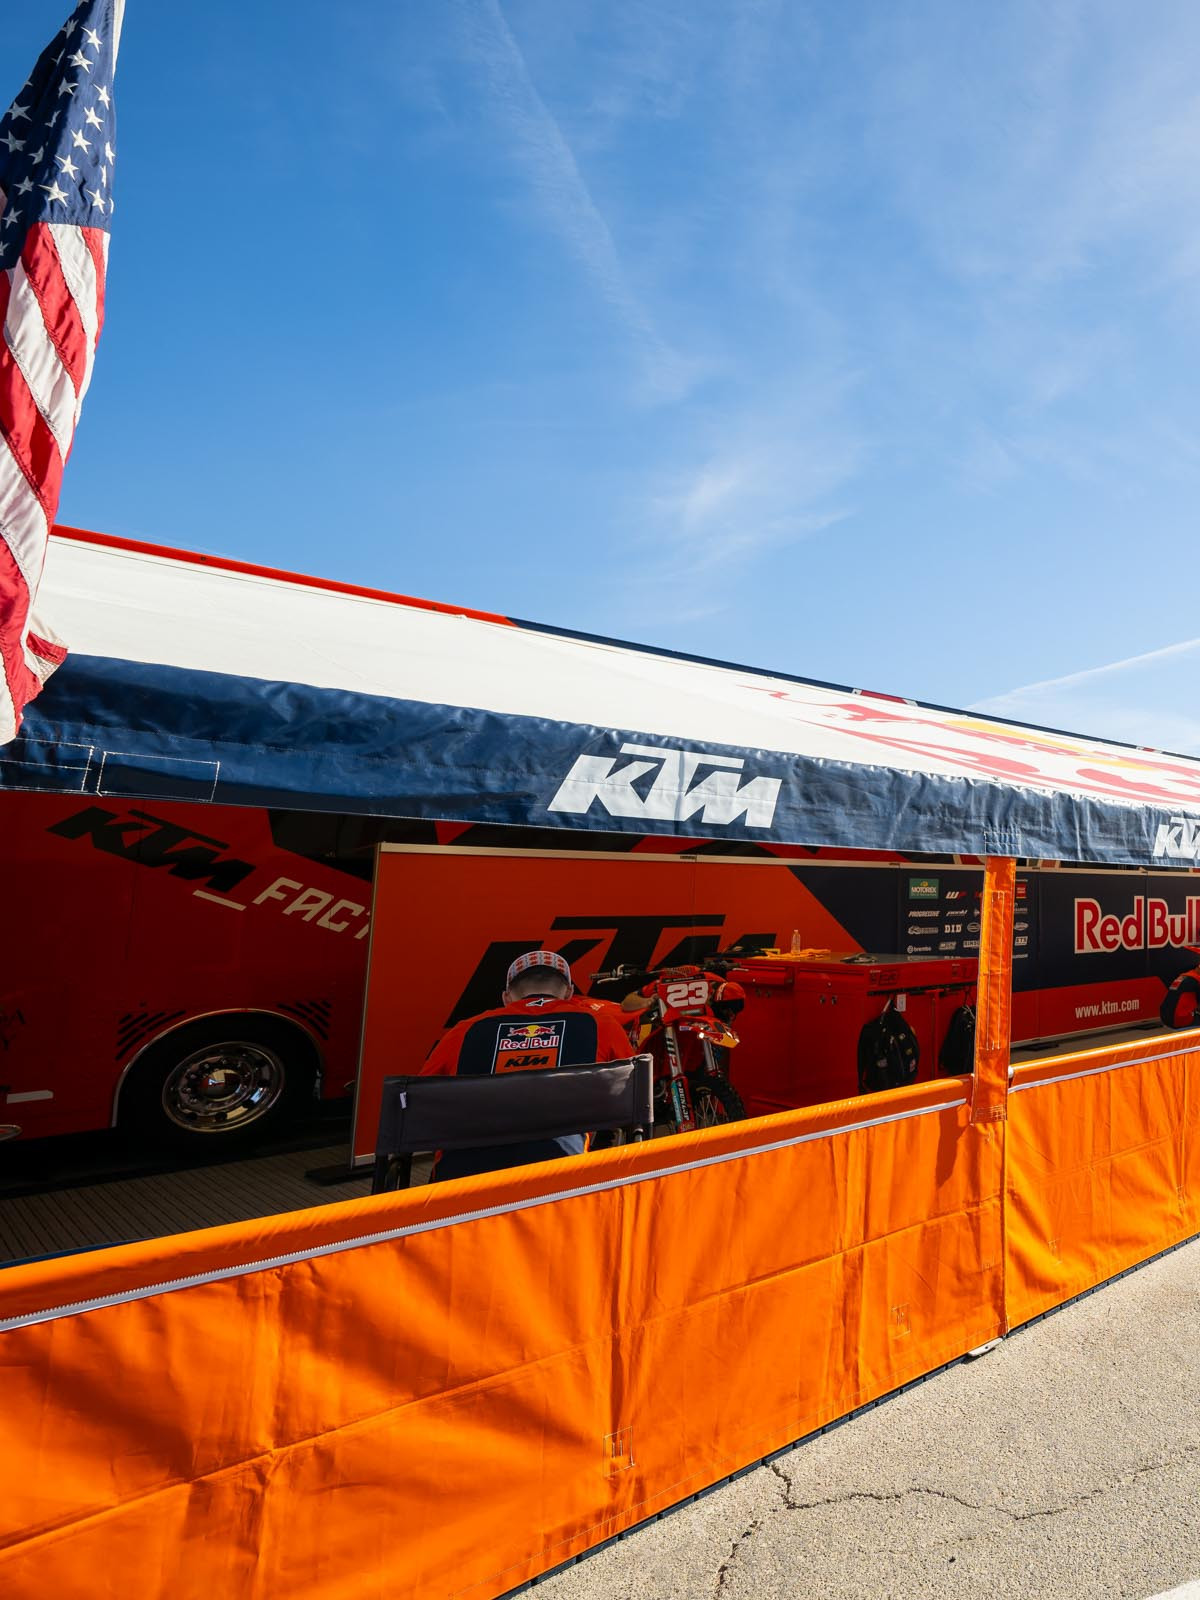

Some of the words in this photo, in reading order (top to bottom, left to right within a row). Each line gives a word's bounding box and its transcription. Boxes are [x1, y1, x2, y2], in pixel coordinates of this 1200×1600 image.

[547, 743, 783, 828] KTM
[45, 806, 256, 893] KTM
[1075, 896, 1145, 954] Red
[667, 981, 709, 1008] 23
[1075, 999, 1140, 1019] www.ktm.com
[500, 1039, 529, 1050] Red
[531, 1036, 560, 1048] Bull
[504, 1054, 550, 1068] KTM
